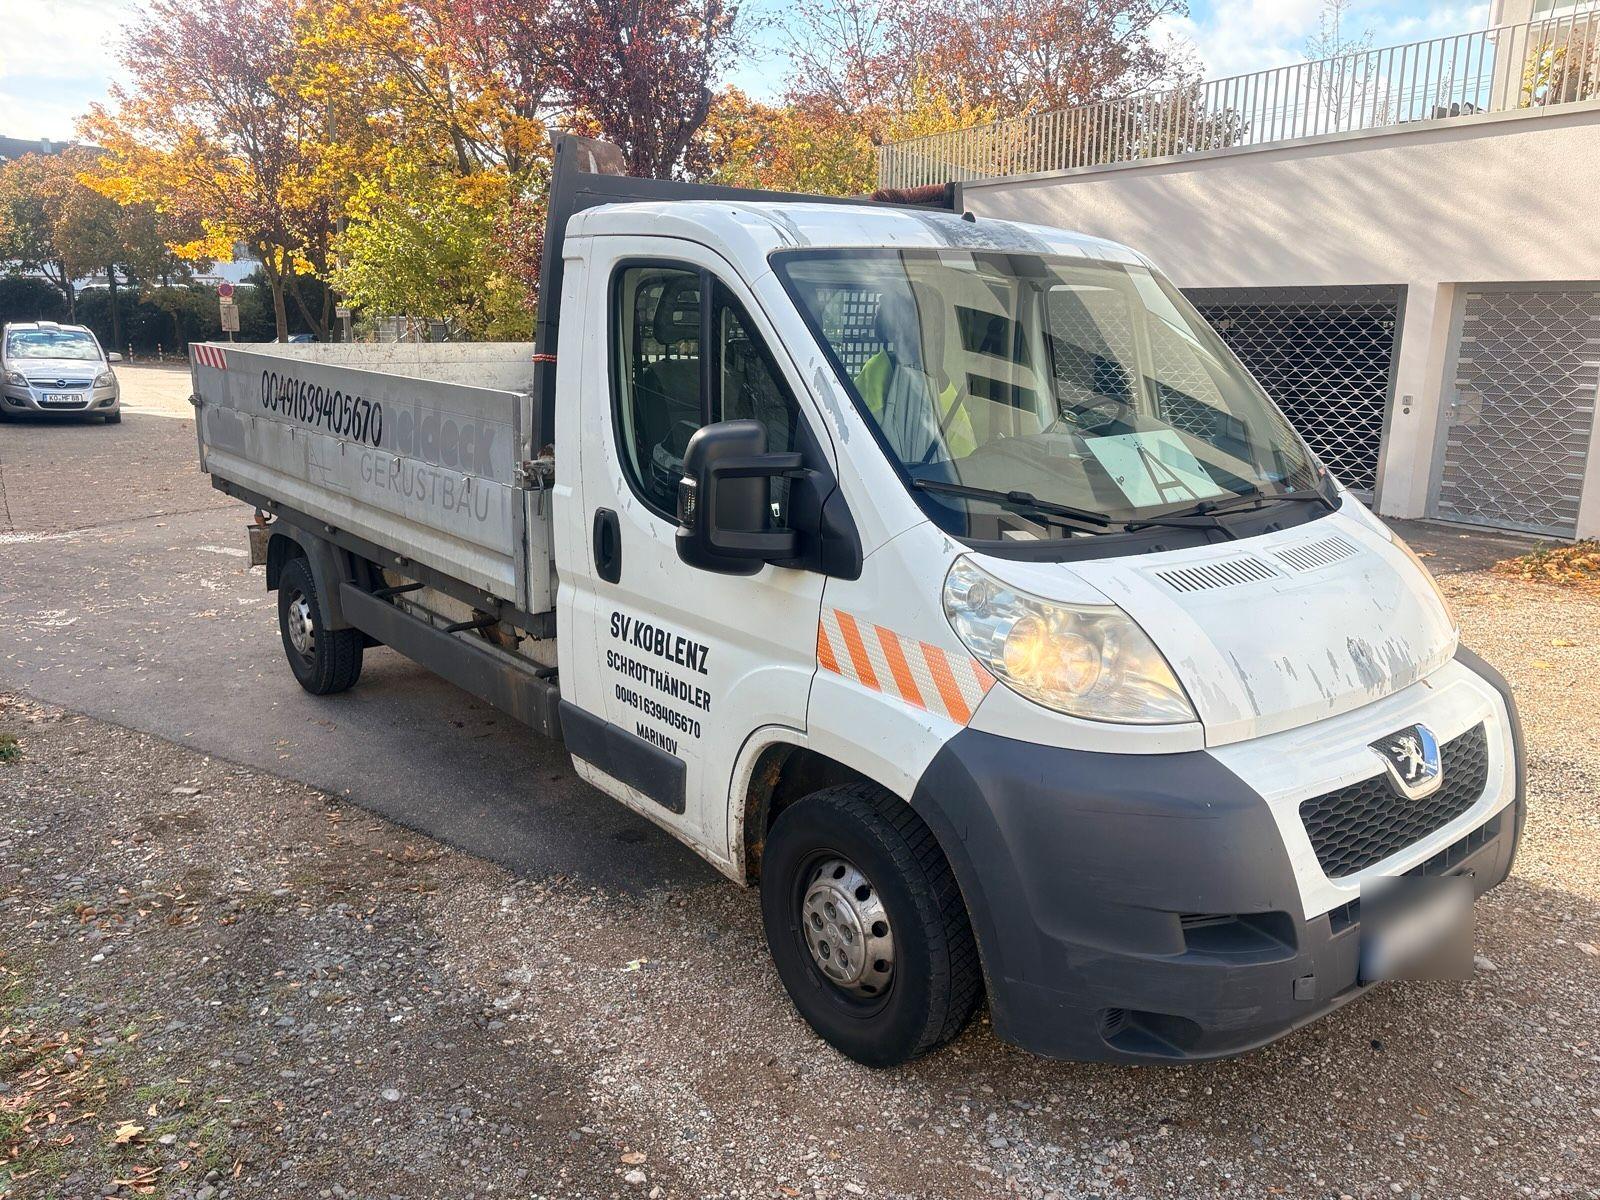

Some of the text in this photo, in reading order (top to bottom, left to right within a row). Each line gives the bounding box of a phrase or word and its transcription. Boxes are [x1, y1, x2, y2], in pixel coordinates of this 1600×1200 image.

[262, 370, 382, 447] 00491639405670
[610, 611, 709, 675] SV.KOBLENZ
[606, 649, 711, 712] SCHROTTHÄNDLER
[615, 684, 701, 739] 00491639405670
[636, 721, 678, 755] MARINOV
